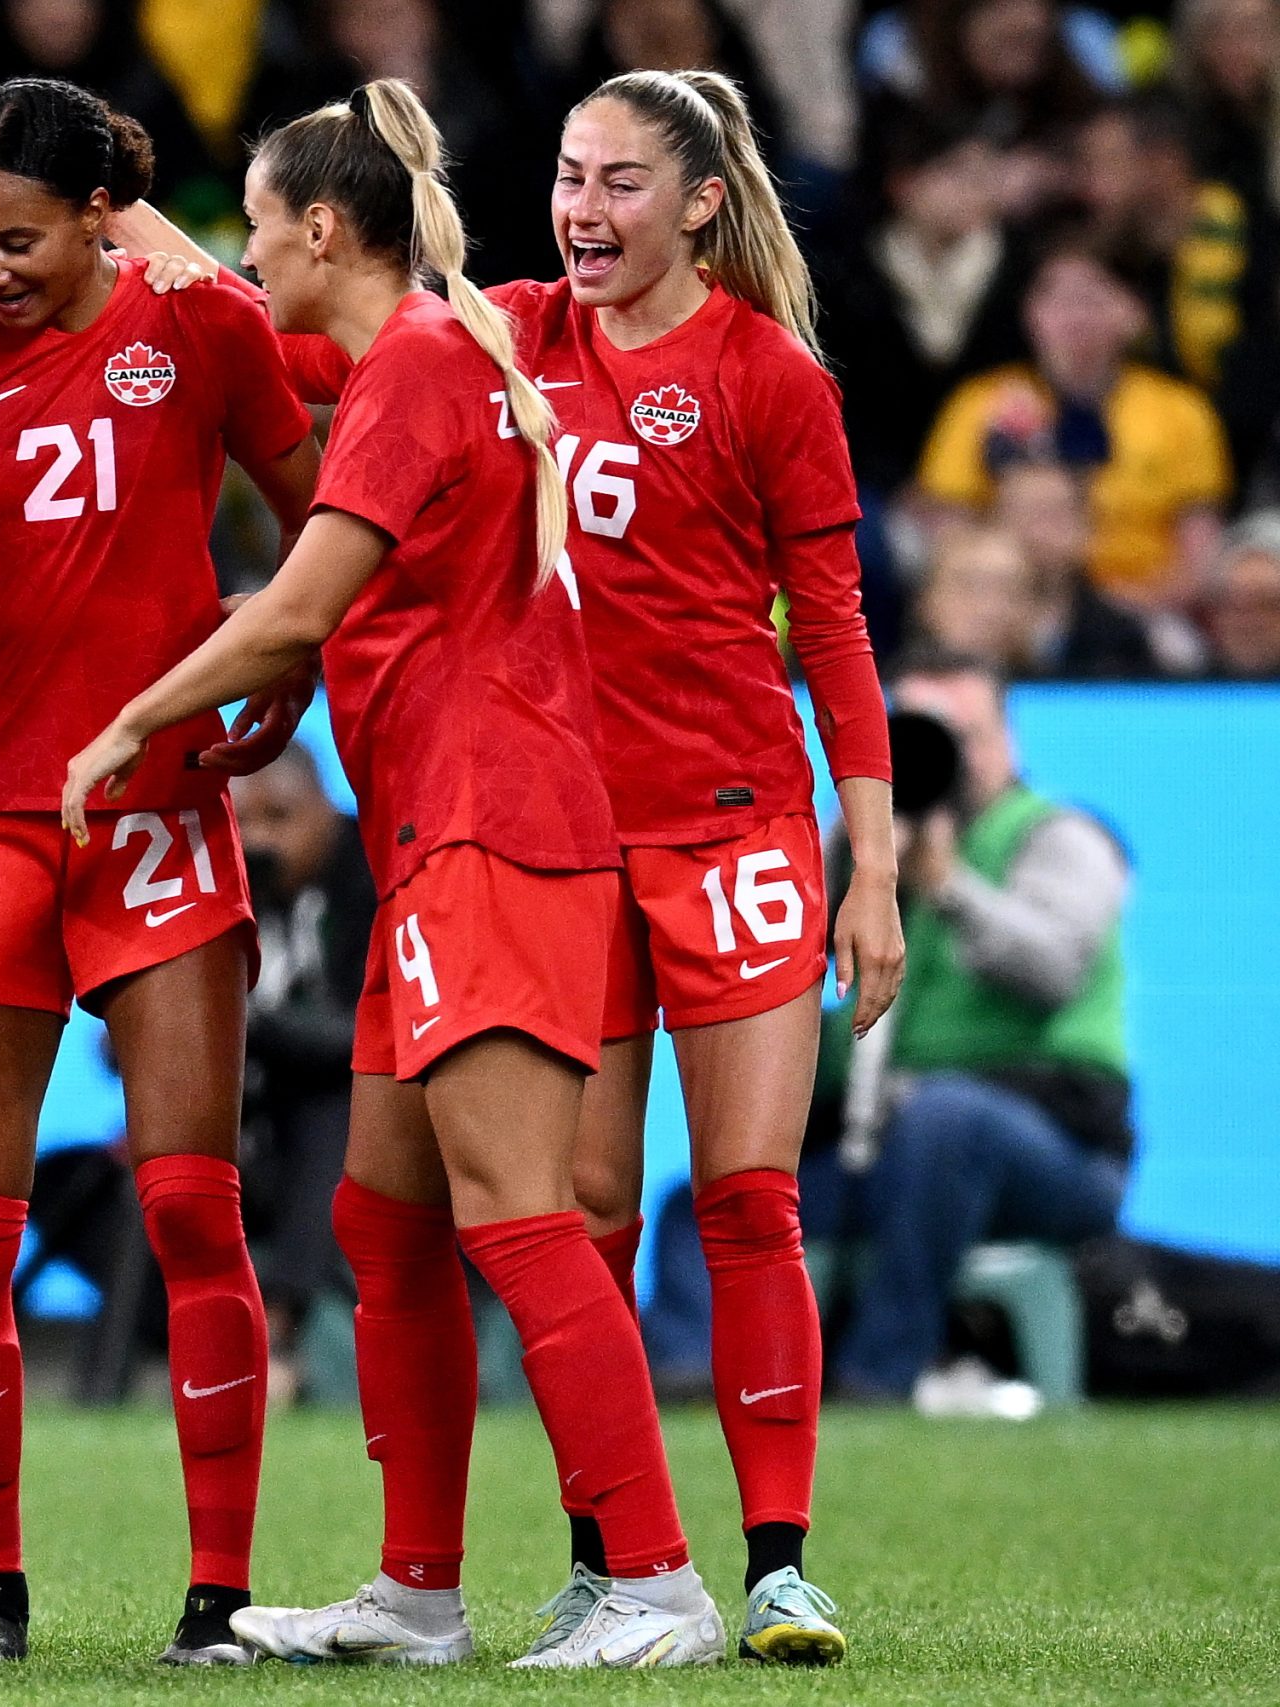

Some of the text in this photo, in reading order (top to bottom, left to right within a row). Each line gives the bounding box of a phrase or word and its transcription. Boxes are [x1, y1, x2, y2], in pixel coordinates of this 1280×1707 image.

[105, 368, 174, 381] CANADA
[634, 405, 697, 425] CANADA
[16, 417, 117, 522] 21
[555, 434, 640, 539] 16
[112, 809, 217, 909] 21
[701, 848, 804, 953] 16
[395, 912, 440, 1008] 4
